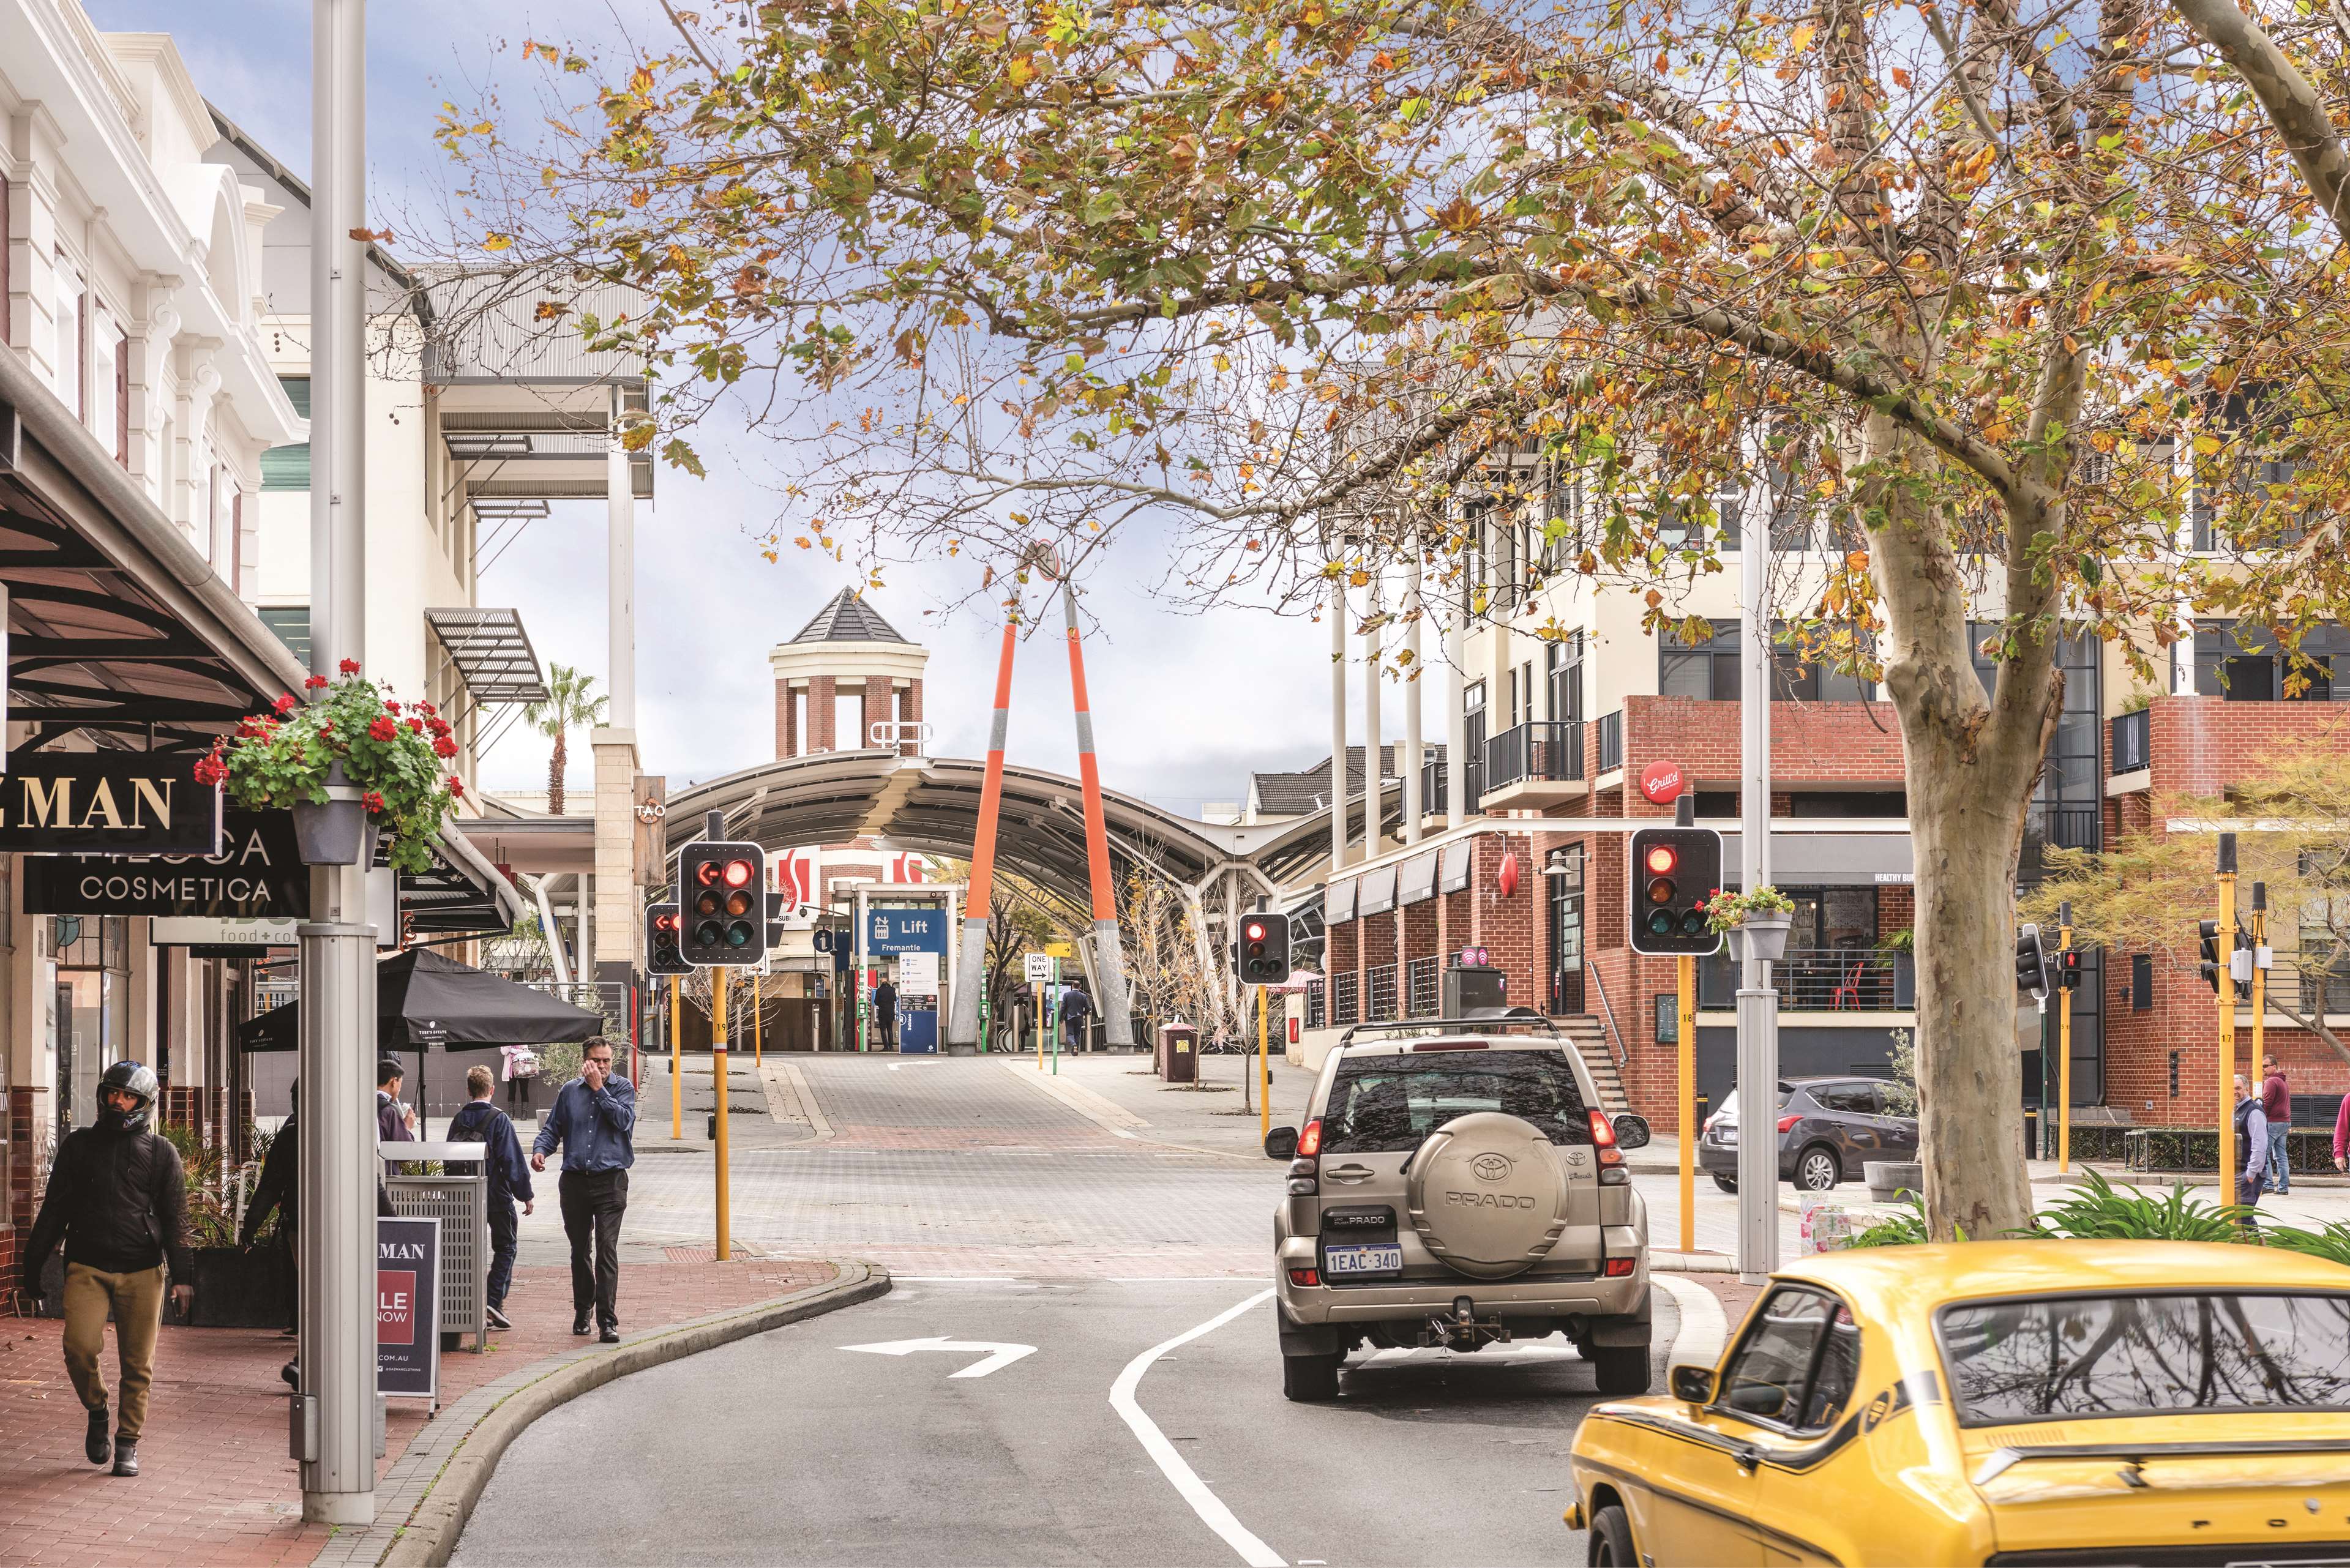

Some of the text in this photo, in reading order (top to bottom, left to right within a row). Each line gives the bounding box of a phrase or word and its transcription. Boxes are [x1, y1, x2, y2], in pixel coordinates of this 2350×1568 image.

[1647, 771, 1678, 794] Grill'd
[0, 777, 176, 830] MAN
[634, 805, 665, 818] TAO
[1875, 873, 1901, 882] HEALTHY
[80, 876, 272, 902] COSMETICA
[901, 920, 928, 933] Lift
[220, 929, 257, 942] food
[1683, 1014, 1693, 1023] 18
[717, 1023, 726, 1032] 19
[1445, 1191, 1536, 1210] PRADO
[378, 1243, 425, 1260] MAN
[377, 1293, 408, 1310] LE
